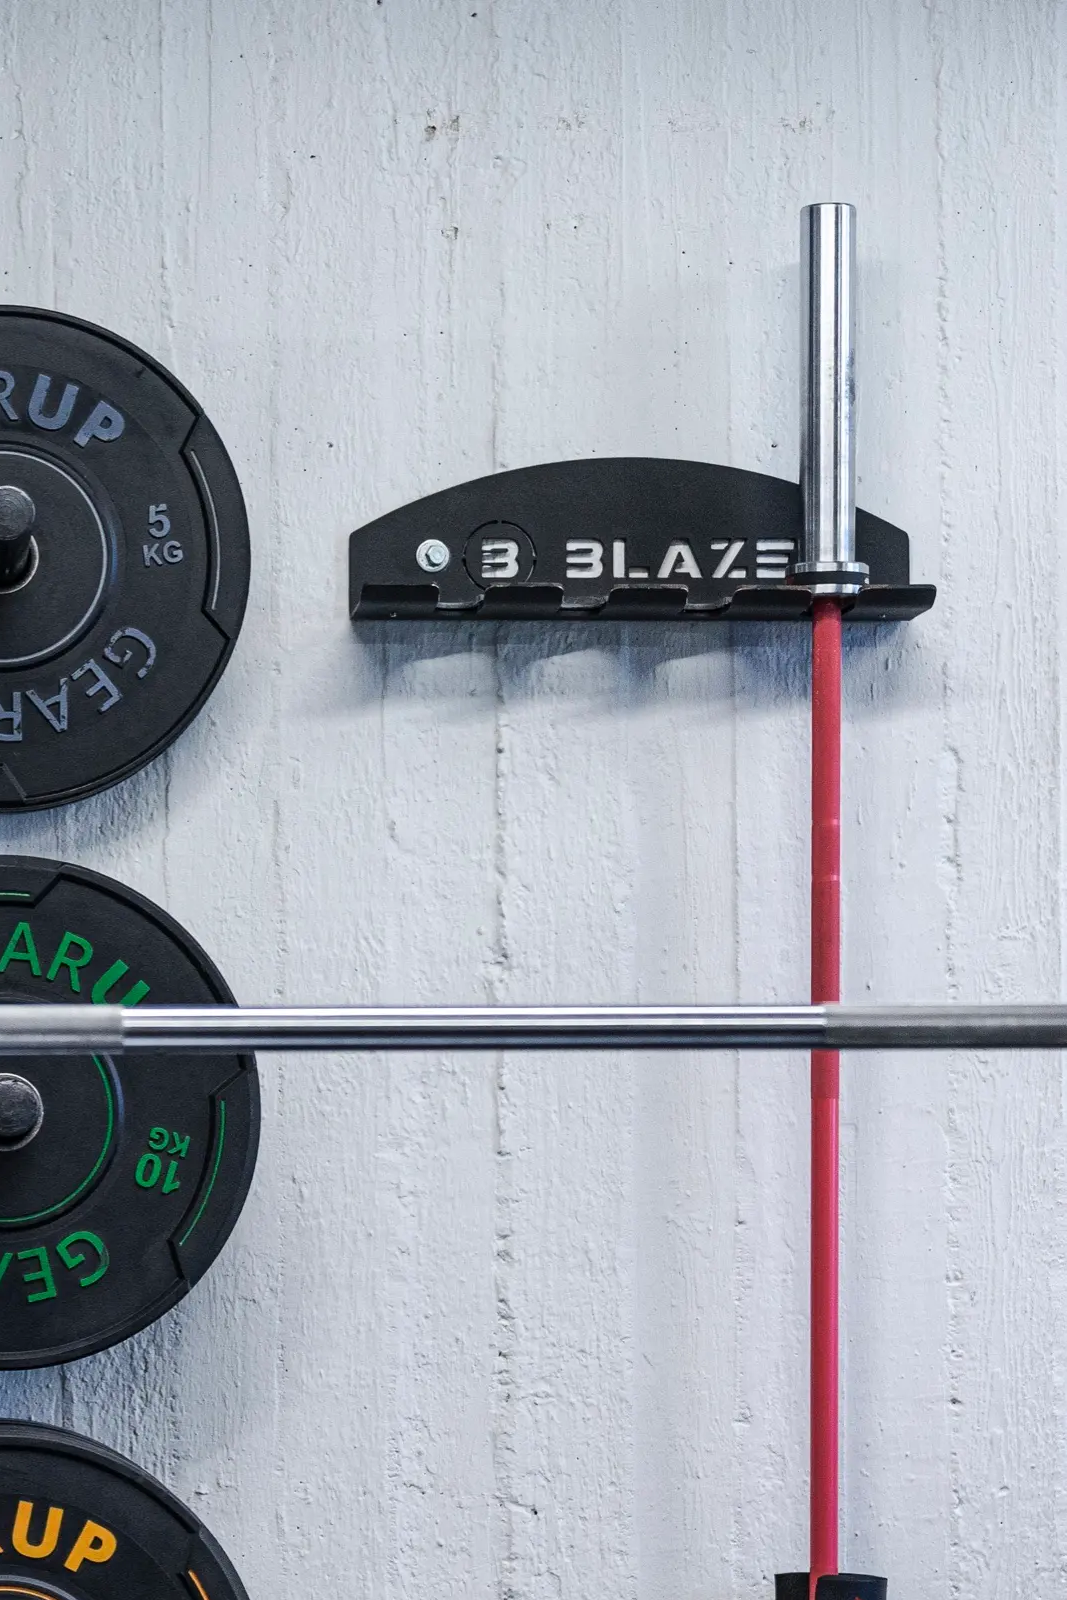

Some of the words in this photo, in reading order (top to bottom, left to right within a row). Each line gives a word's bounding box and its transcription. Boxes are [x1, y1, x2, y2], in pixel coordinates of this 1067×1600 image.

[147, 504, 171, 538] 5
[143, 541, 184, 567] KG
[565, 538, 795, 580] BLAZE
[149, 1127, 191, 1158] KG
[135, 1153, 181, 1194] 10
